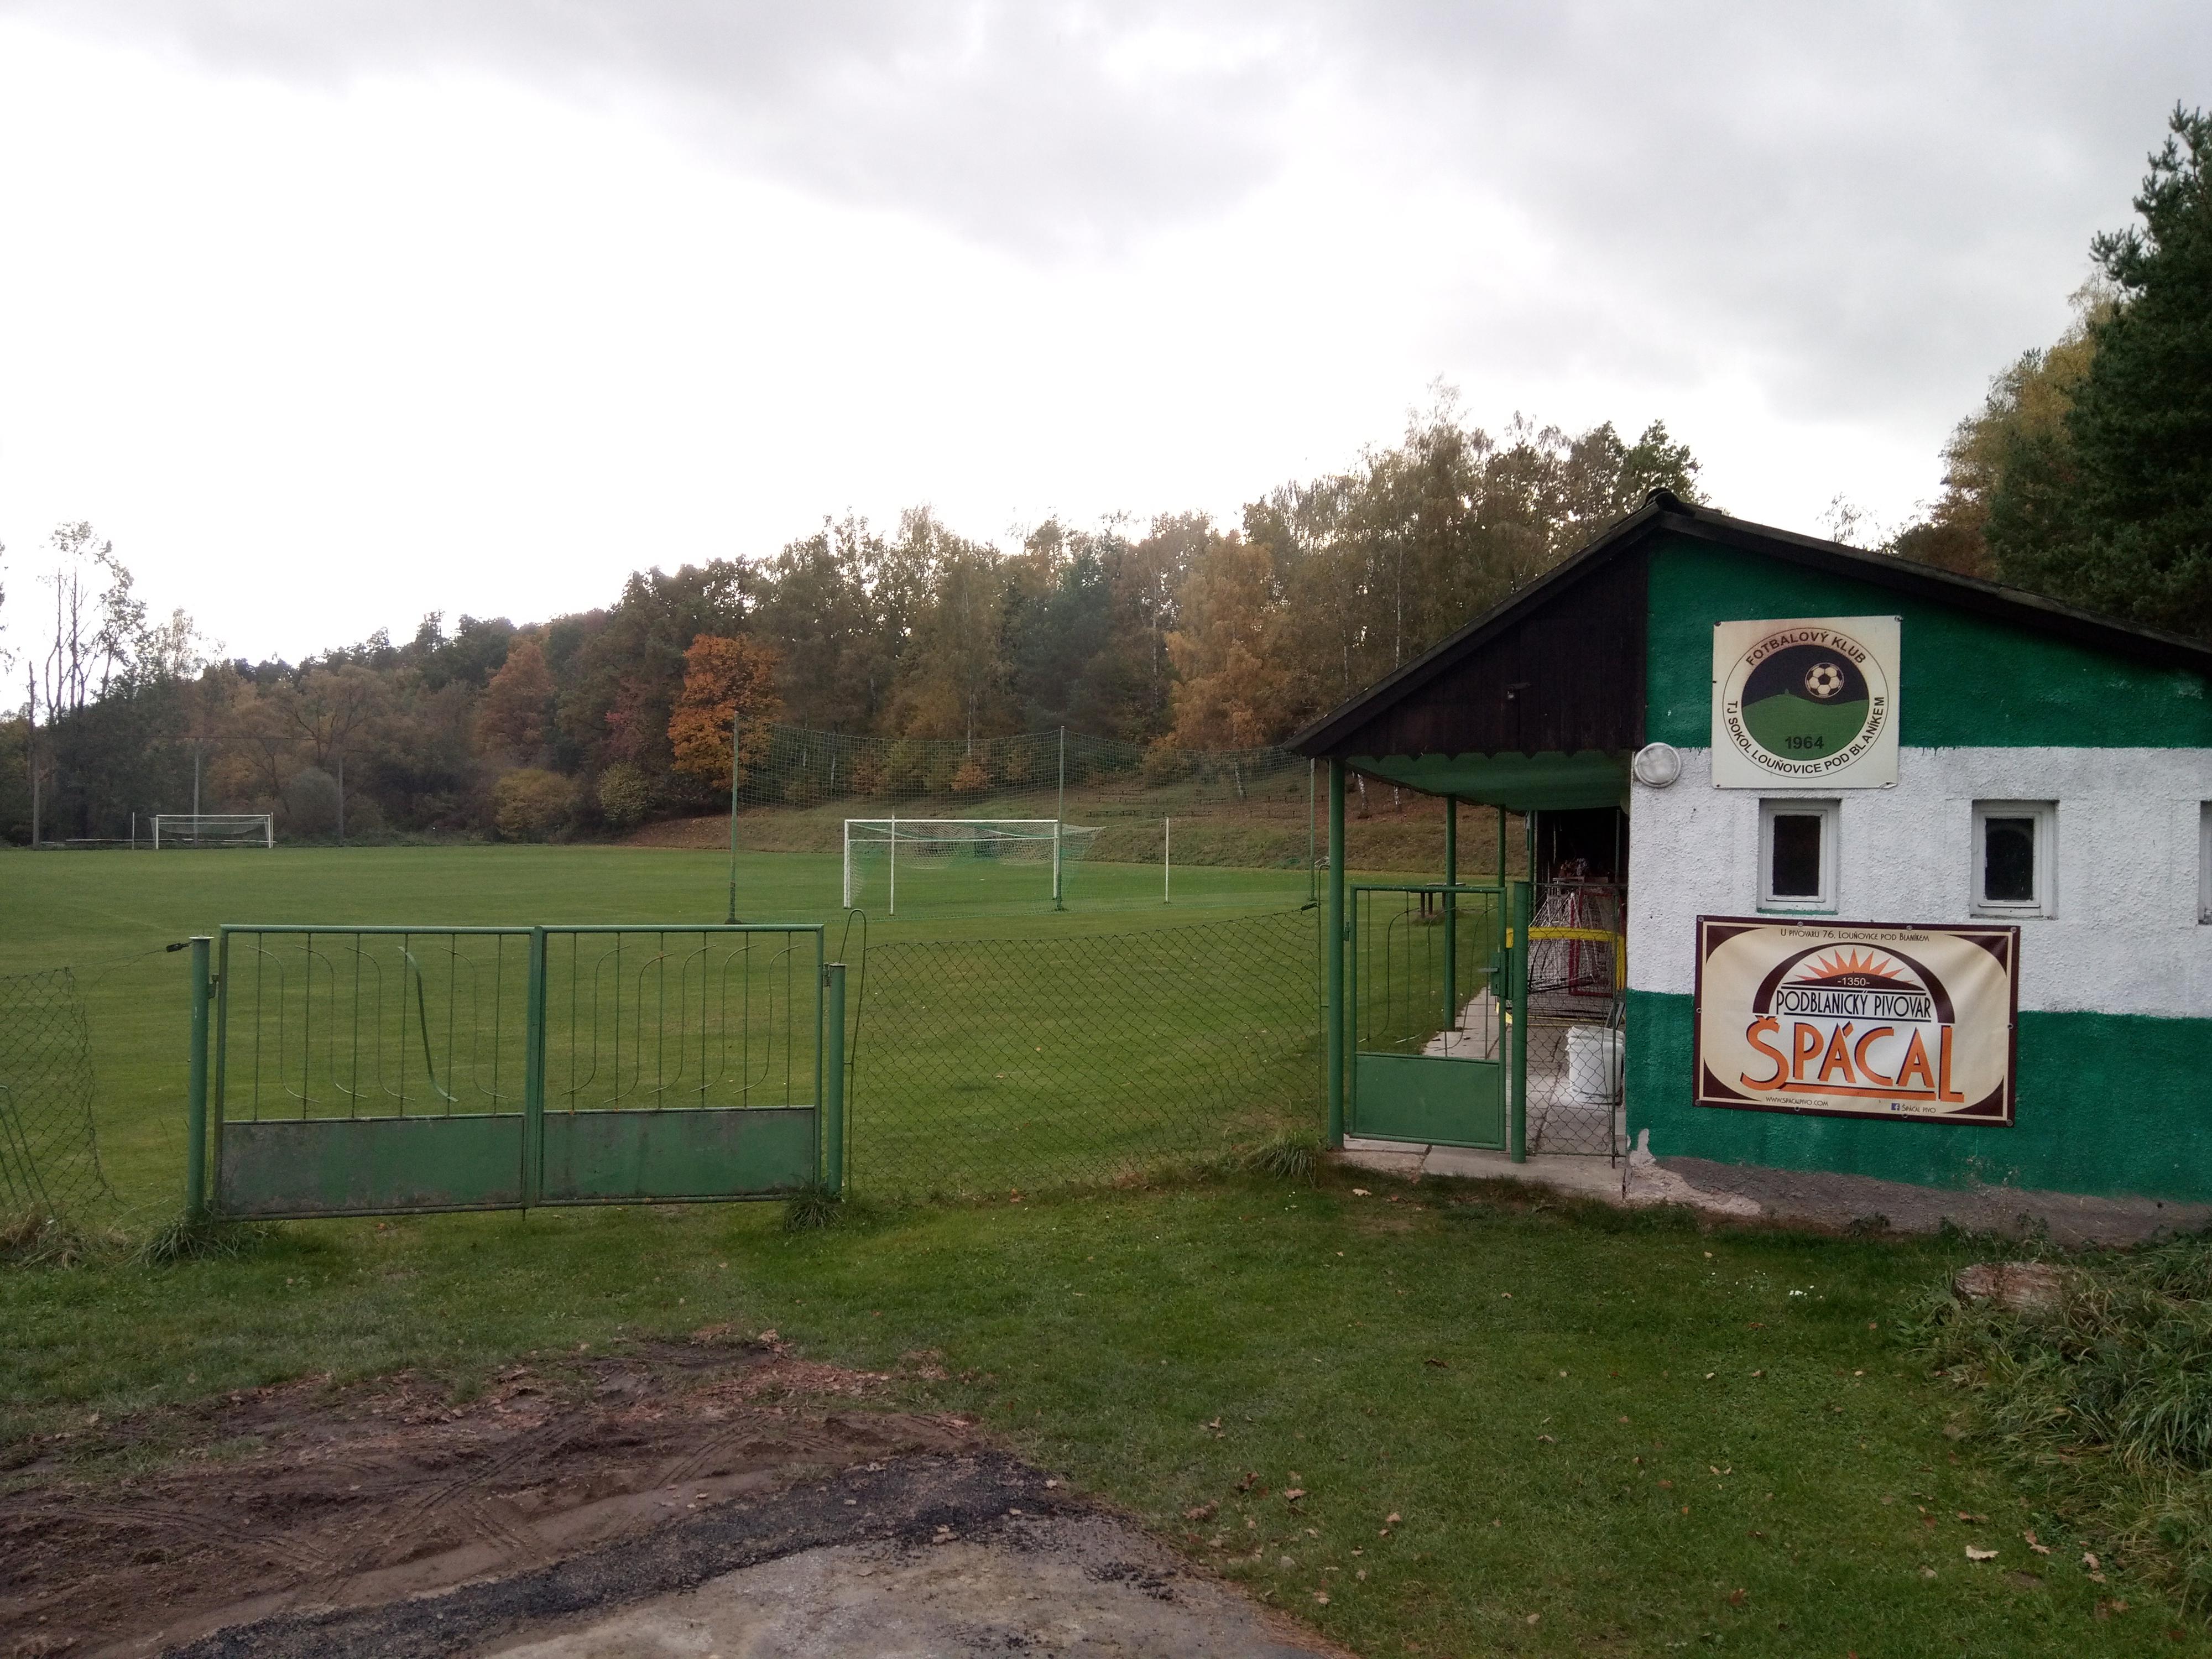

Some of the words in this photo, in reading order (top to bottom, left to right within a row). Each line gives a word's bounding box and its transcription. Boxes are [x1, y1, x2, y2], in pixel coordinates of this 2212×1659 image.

[1745, 631, 1829, 666] FOTBALOVÝ
[1831, 637, 1867, 664] KLUB
[1727, 700, 1738, 714] TJ
[1728, 717, 1751, 753] SOKOL
[1848, 696, 1885, 756] BLANÍKEM
[1785, 735, 1824, 749] 1964
[1751, 749, 1822, 774] LOUŇOVICE
[1824, 753, 1850, 770] POD
[1776, 990, 1869, 1016] PODBLANICKÝ
[1874, 995, 1932, 1018] PIVOVAR
[1739, 1014, 1965, 1103] ŠPÁCAL
